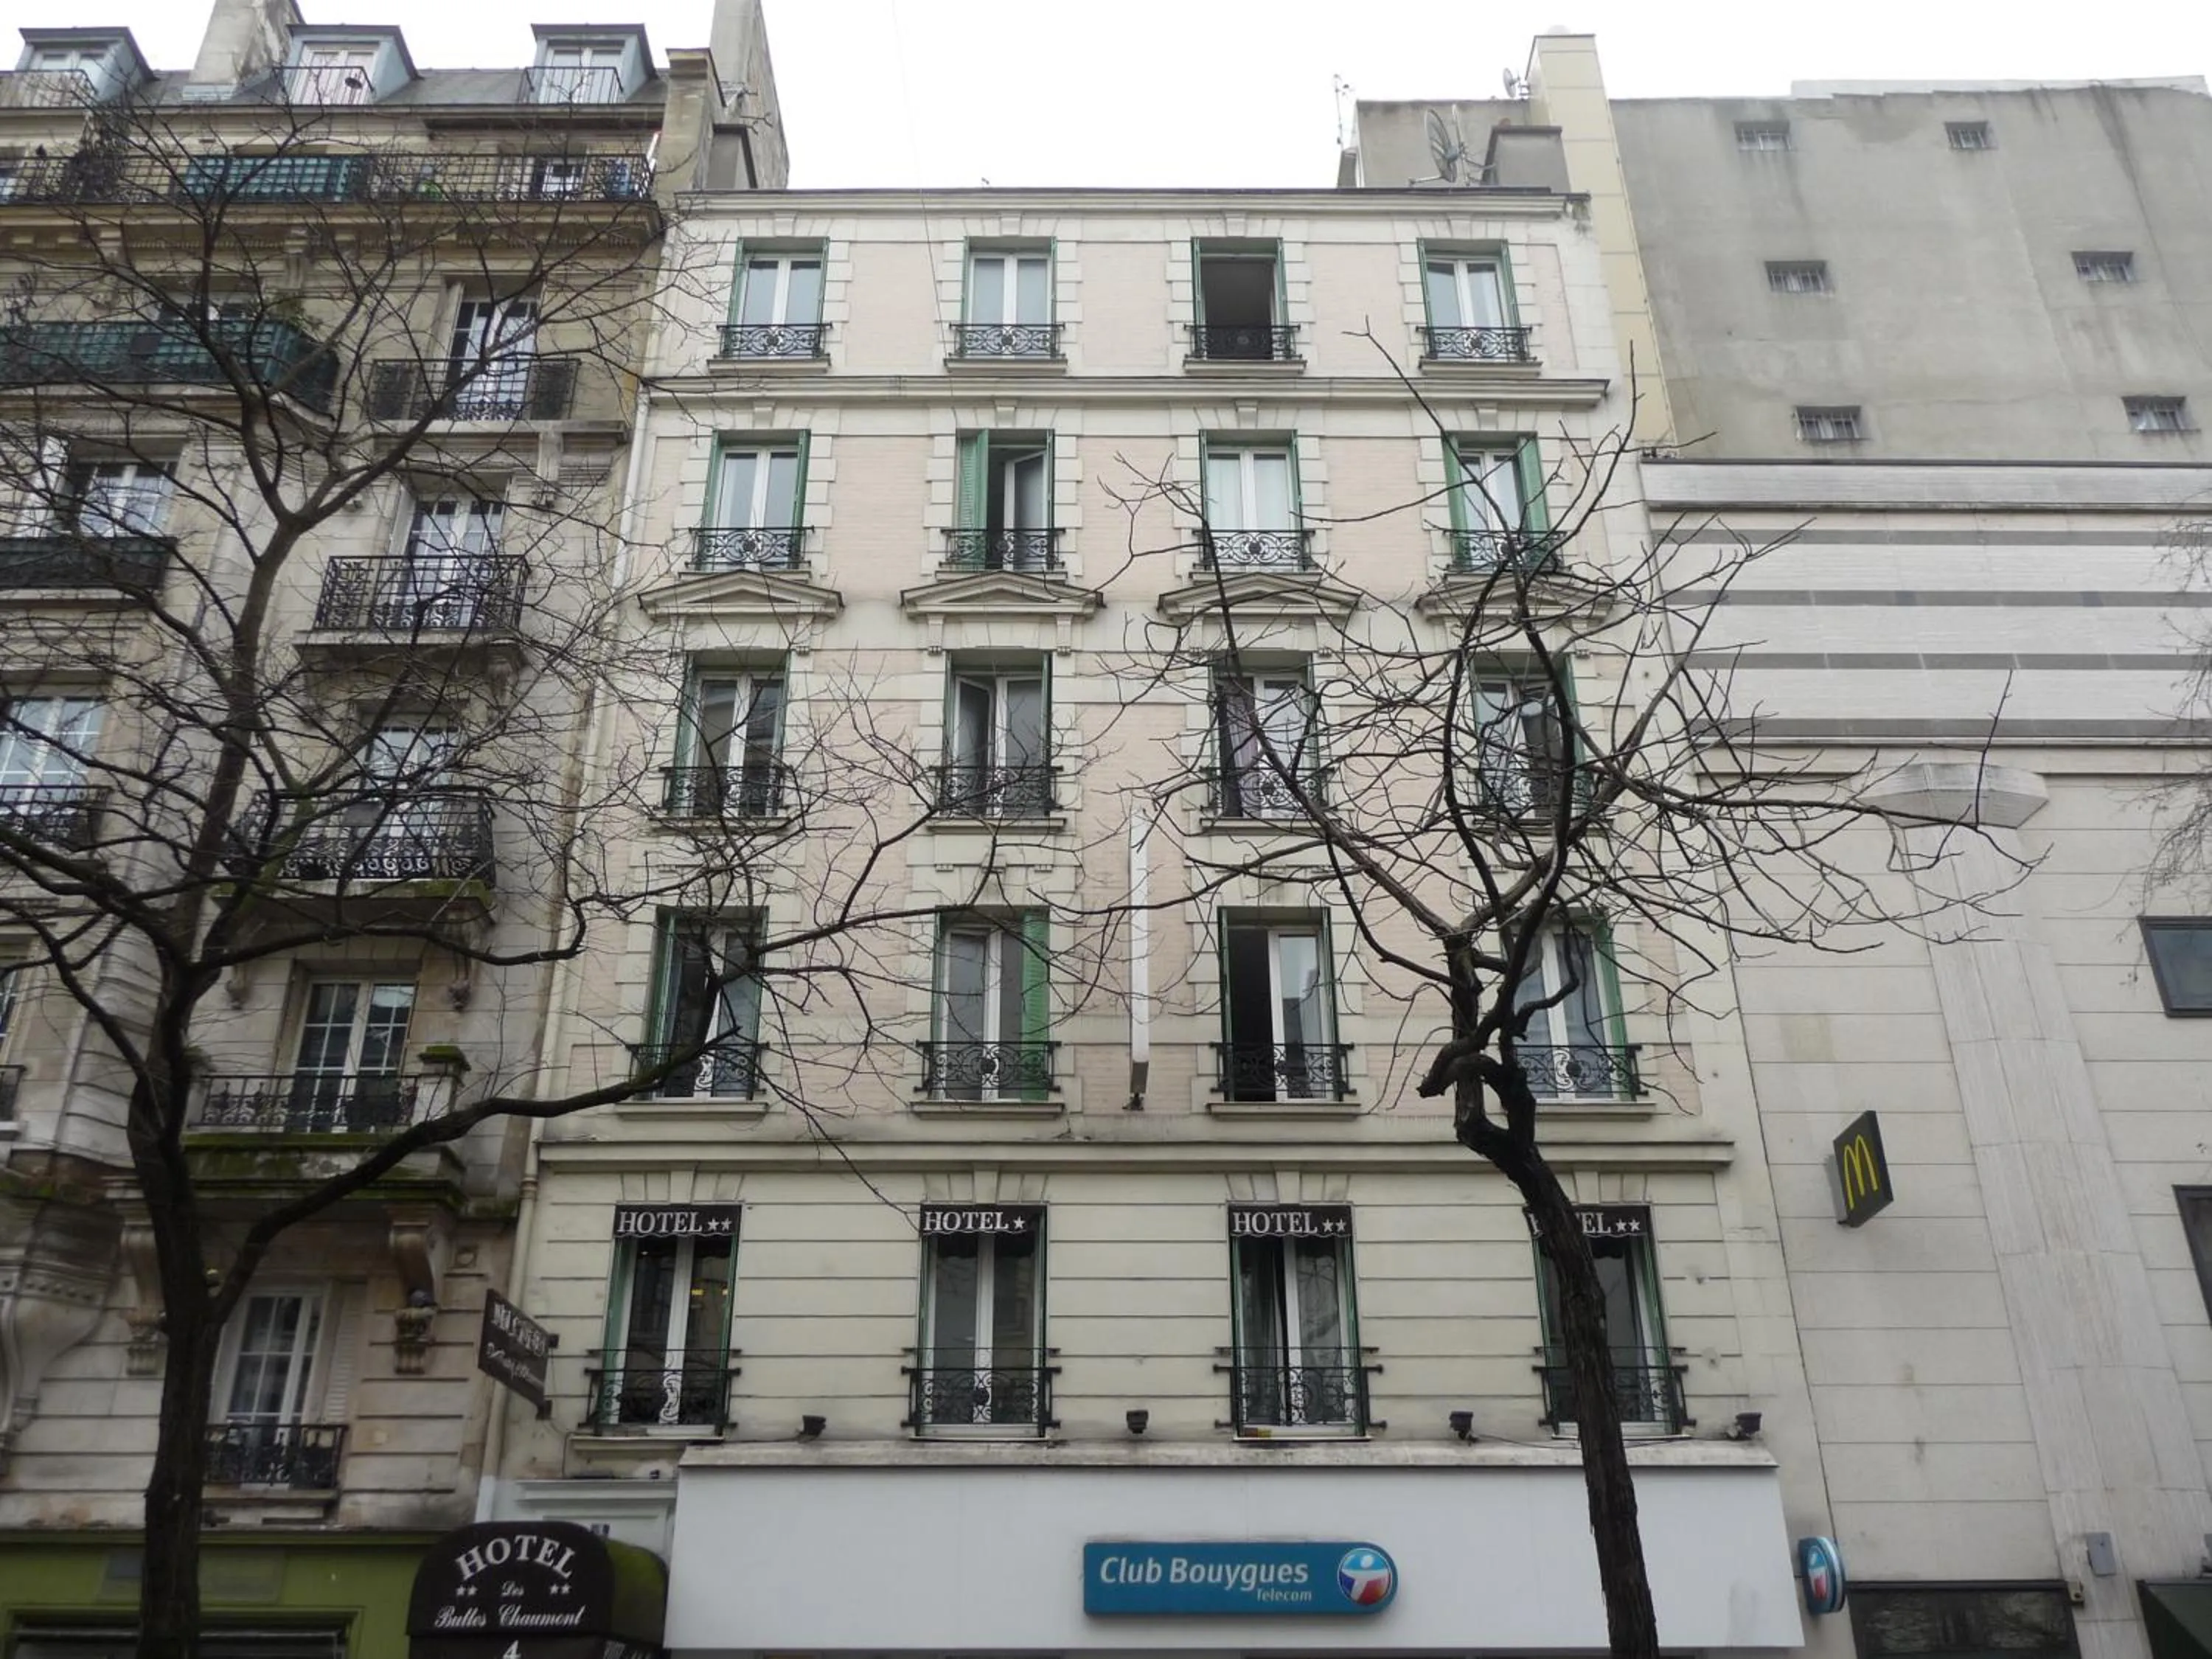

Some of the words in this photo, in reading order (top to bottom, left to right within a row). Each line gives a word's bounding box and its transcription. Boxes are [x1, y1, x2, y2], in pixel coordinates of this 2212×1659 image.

[617, 1211, 703, 1234] HOTEL
[923, 1211, 1009, 1231] HOTEL
[1233, 1211, 1318, 1234] HOTEL
[455, 1534, 575, 1581] HOTEL
[1099, 1557, 1163, 1584] Club
[1169, 1557, 1310, 1591] Bouygues
[1256, 1587, 1312, 1602] Telecom
[498, 1604, 586, 1627] Chaumont
